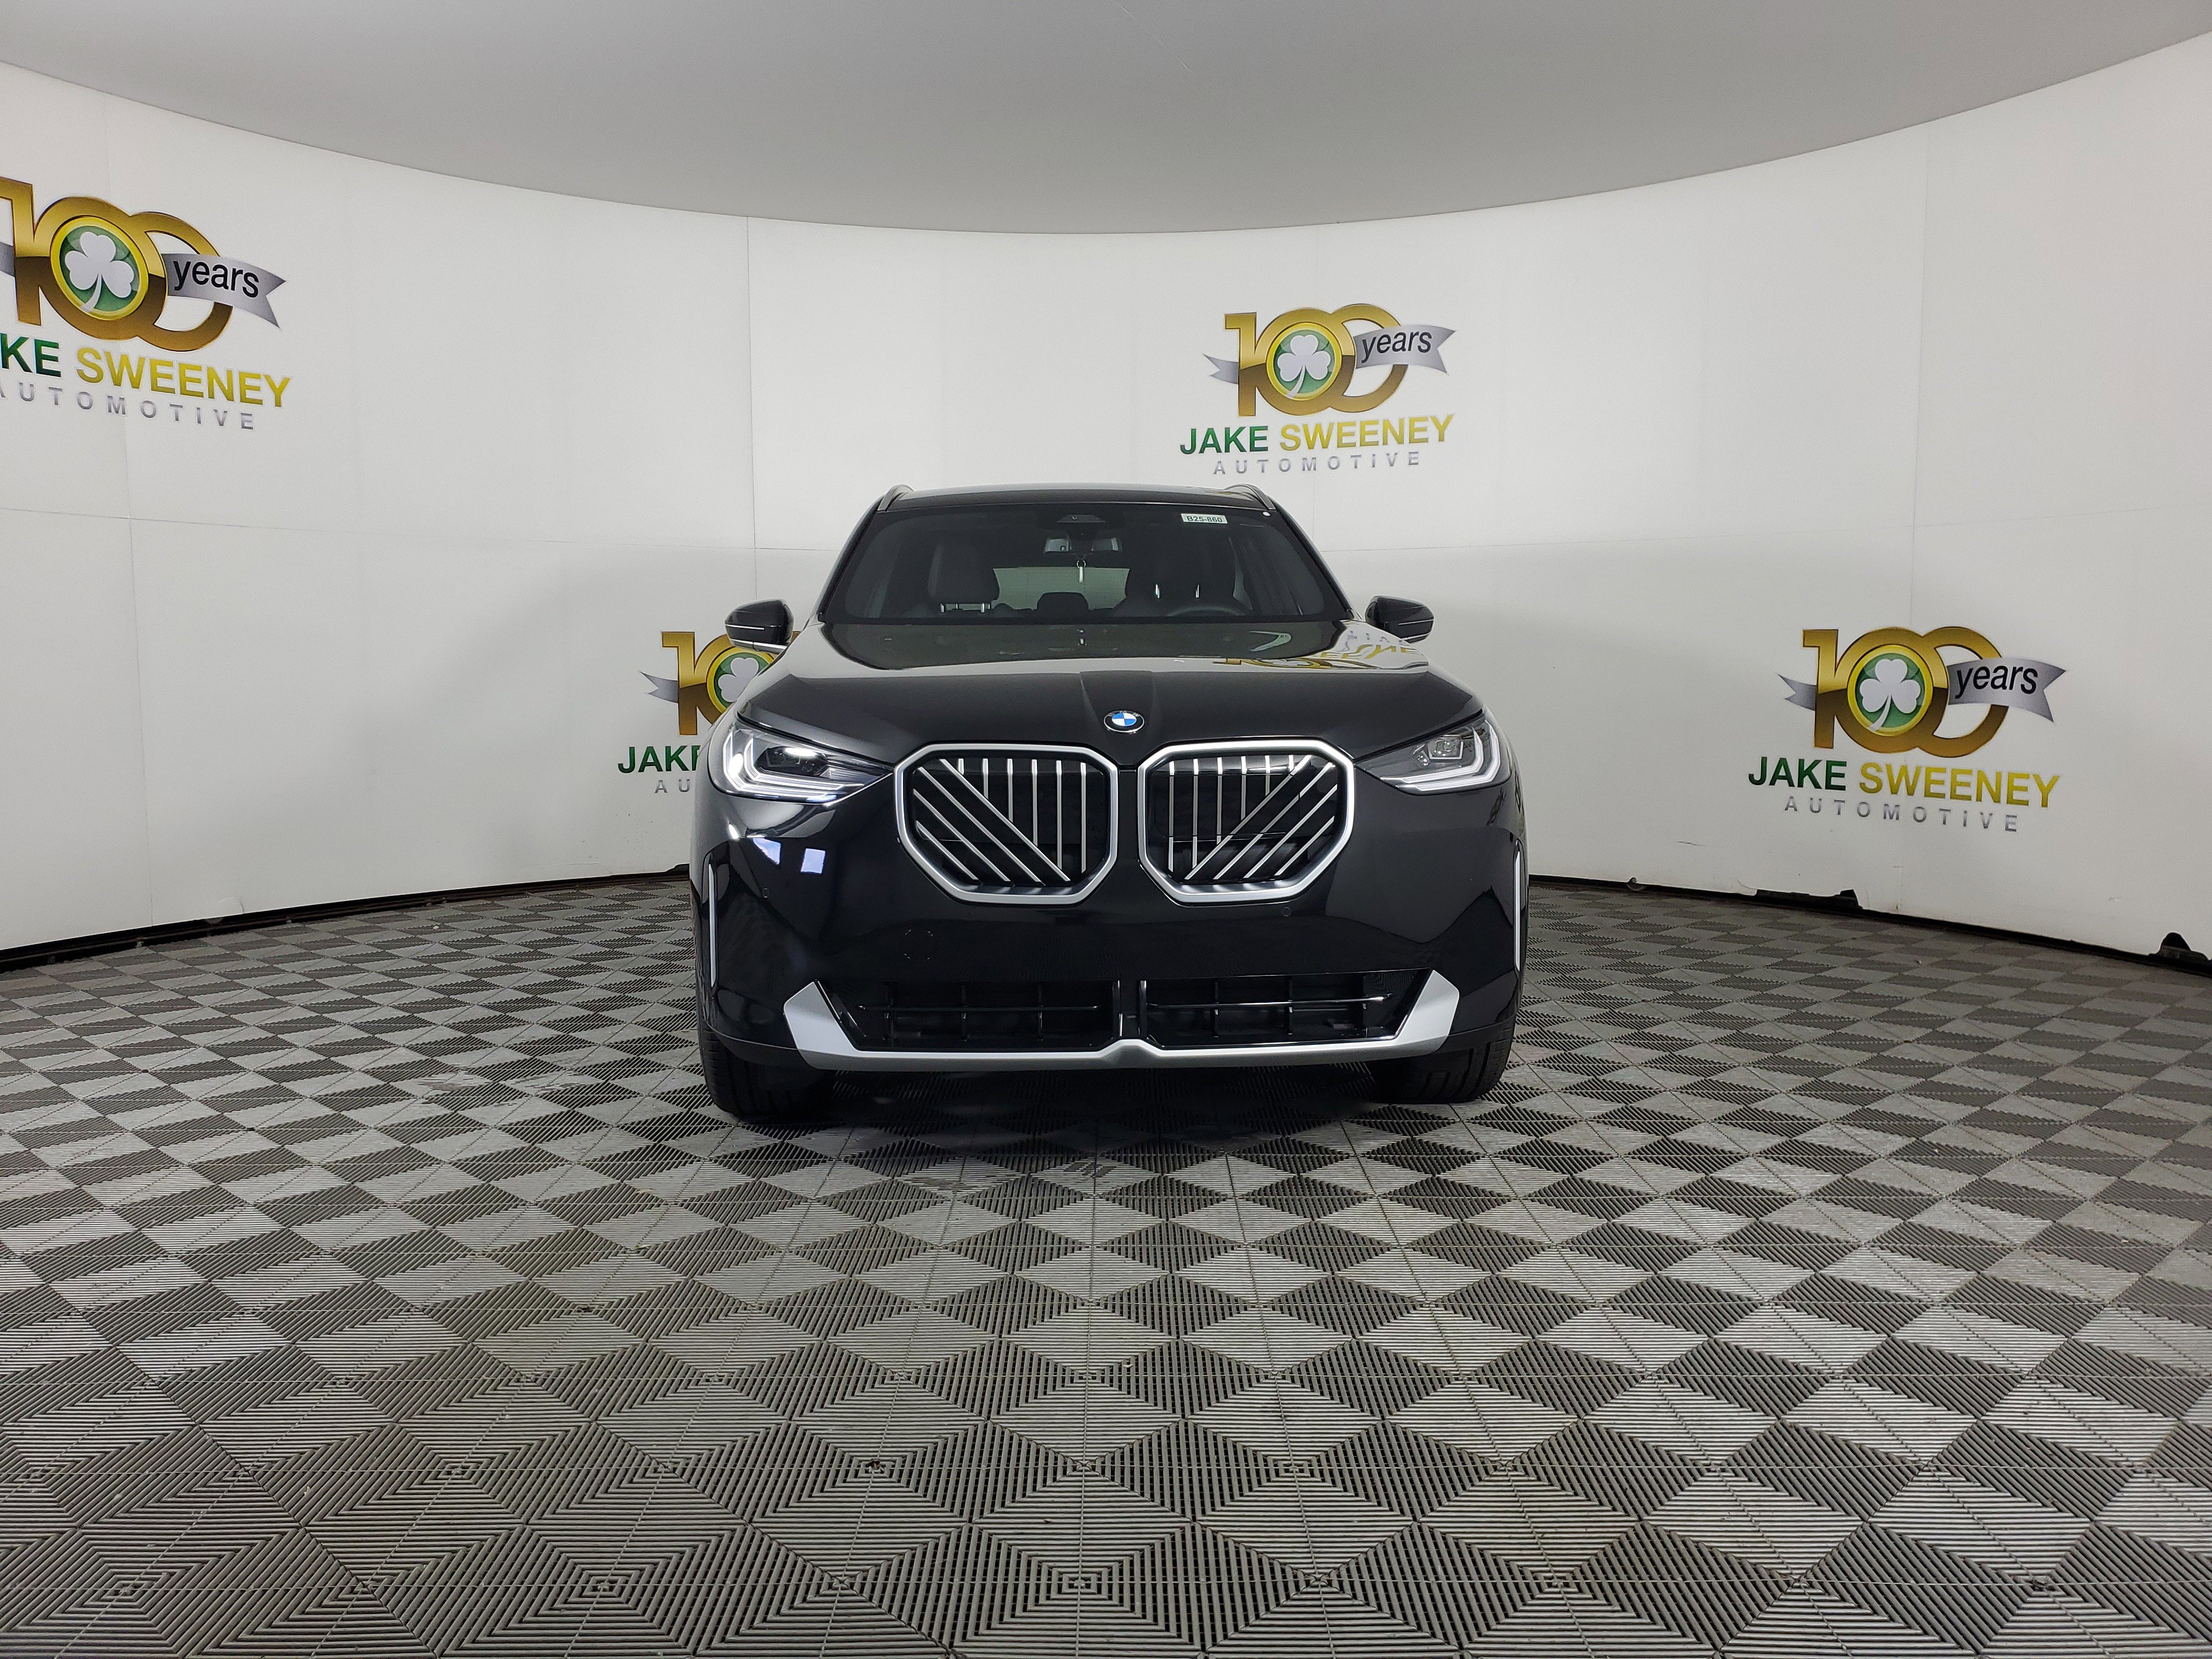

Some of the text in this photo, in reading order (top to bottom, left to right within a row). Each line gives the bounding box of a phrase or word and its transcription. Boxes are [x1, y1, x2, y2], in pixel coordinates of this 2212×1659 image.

[173, 259, 259, 298] years
[0, 332, 292, 408] KE SWEENEY
[1224, 303, 1432, 417] 100 years
[1180, 414, 1454, 455] JAKE SWEENEY
[1213, 451, 1420, 475] AUTOMOTIVE
[1802, 626, 2039, 758] 100 years
[1748, 756, 2060, 808] JAKE SWEENEY
[1784, 796, 2018, 832] AUTOMOTIVE
